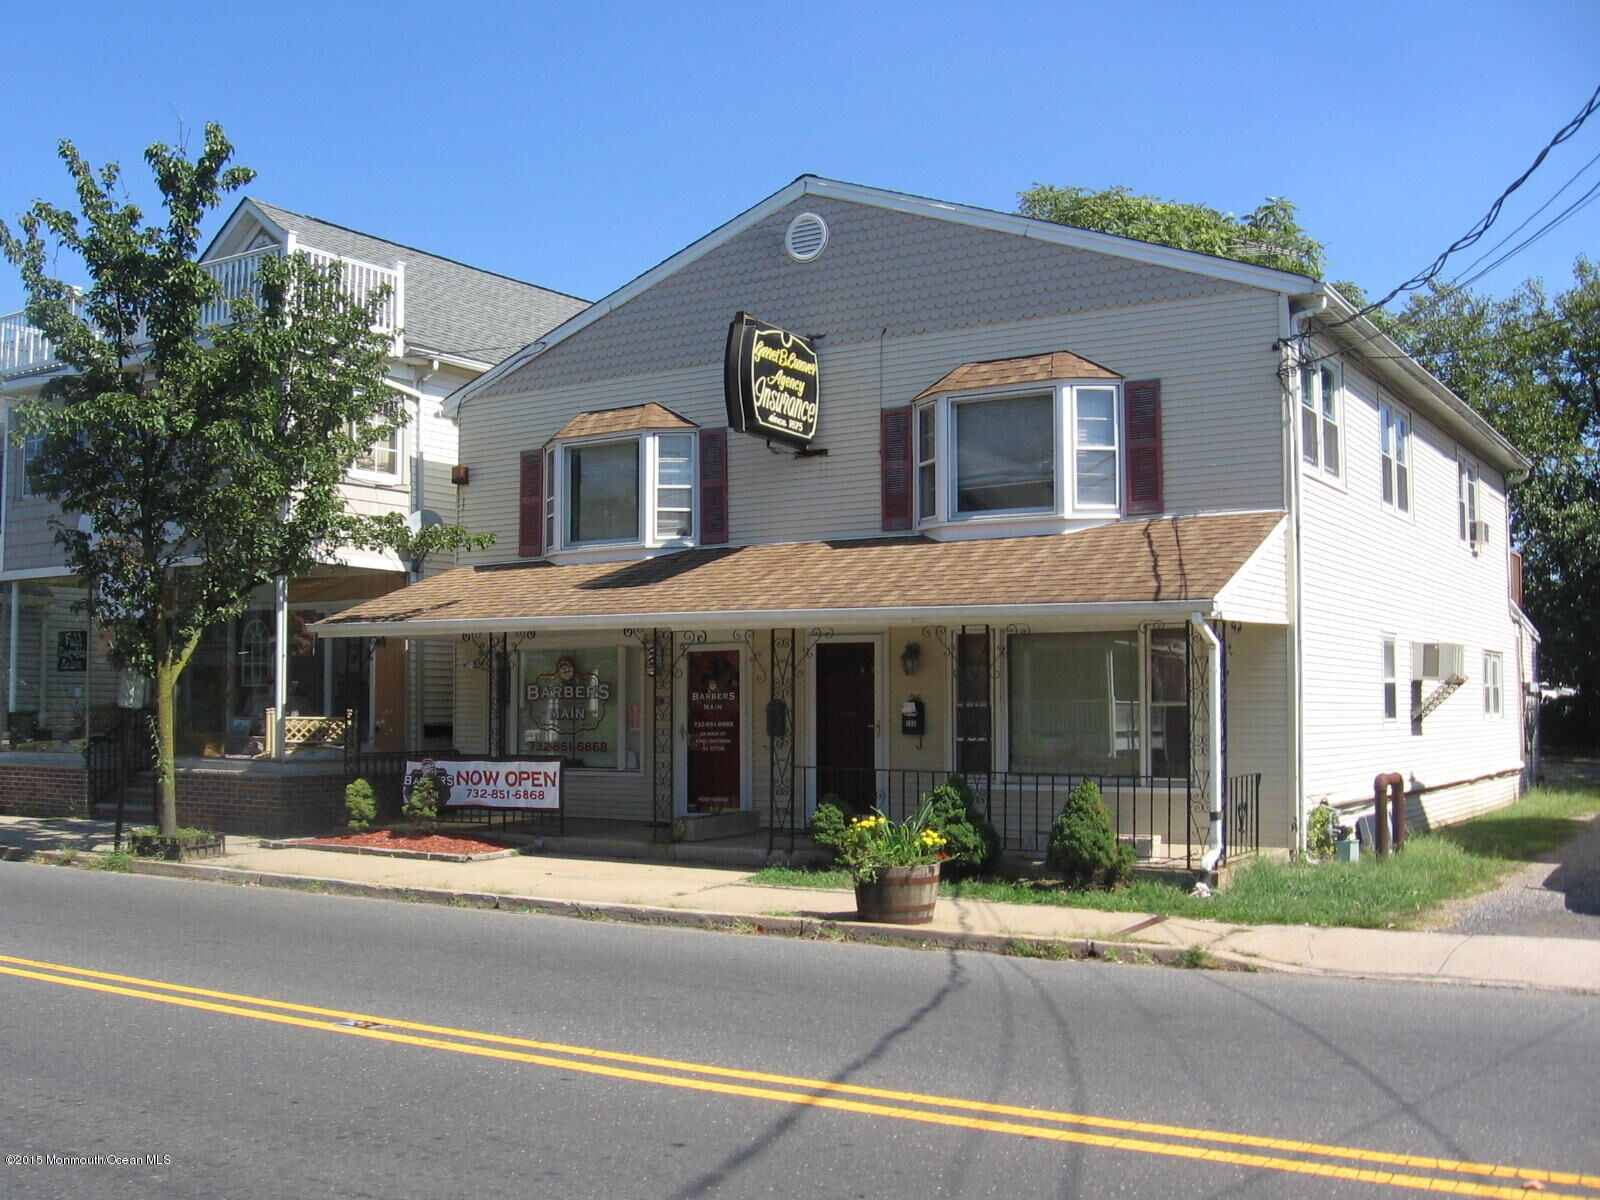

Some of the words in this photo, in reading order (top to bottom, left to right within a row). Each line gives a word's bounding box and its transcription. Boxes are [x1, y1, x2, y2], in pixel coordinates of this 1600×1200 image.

[767, 369, 806, 397] Agency
[755, 376, 816, 423] Insurance
[527, 684, 610, 700] BARBERS
[692, 691, 736, 701] BARBERS
[546, 708, 585, 719] MAIN
[703, 703, 723, 711] MAIN
[456, 770, 500, 786] NOW
[504, 770, 557, 788] OPEN
[466, 788, 545, 800] 732-851-6868
